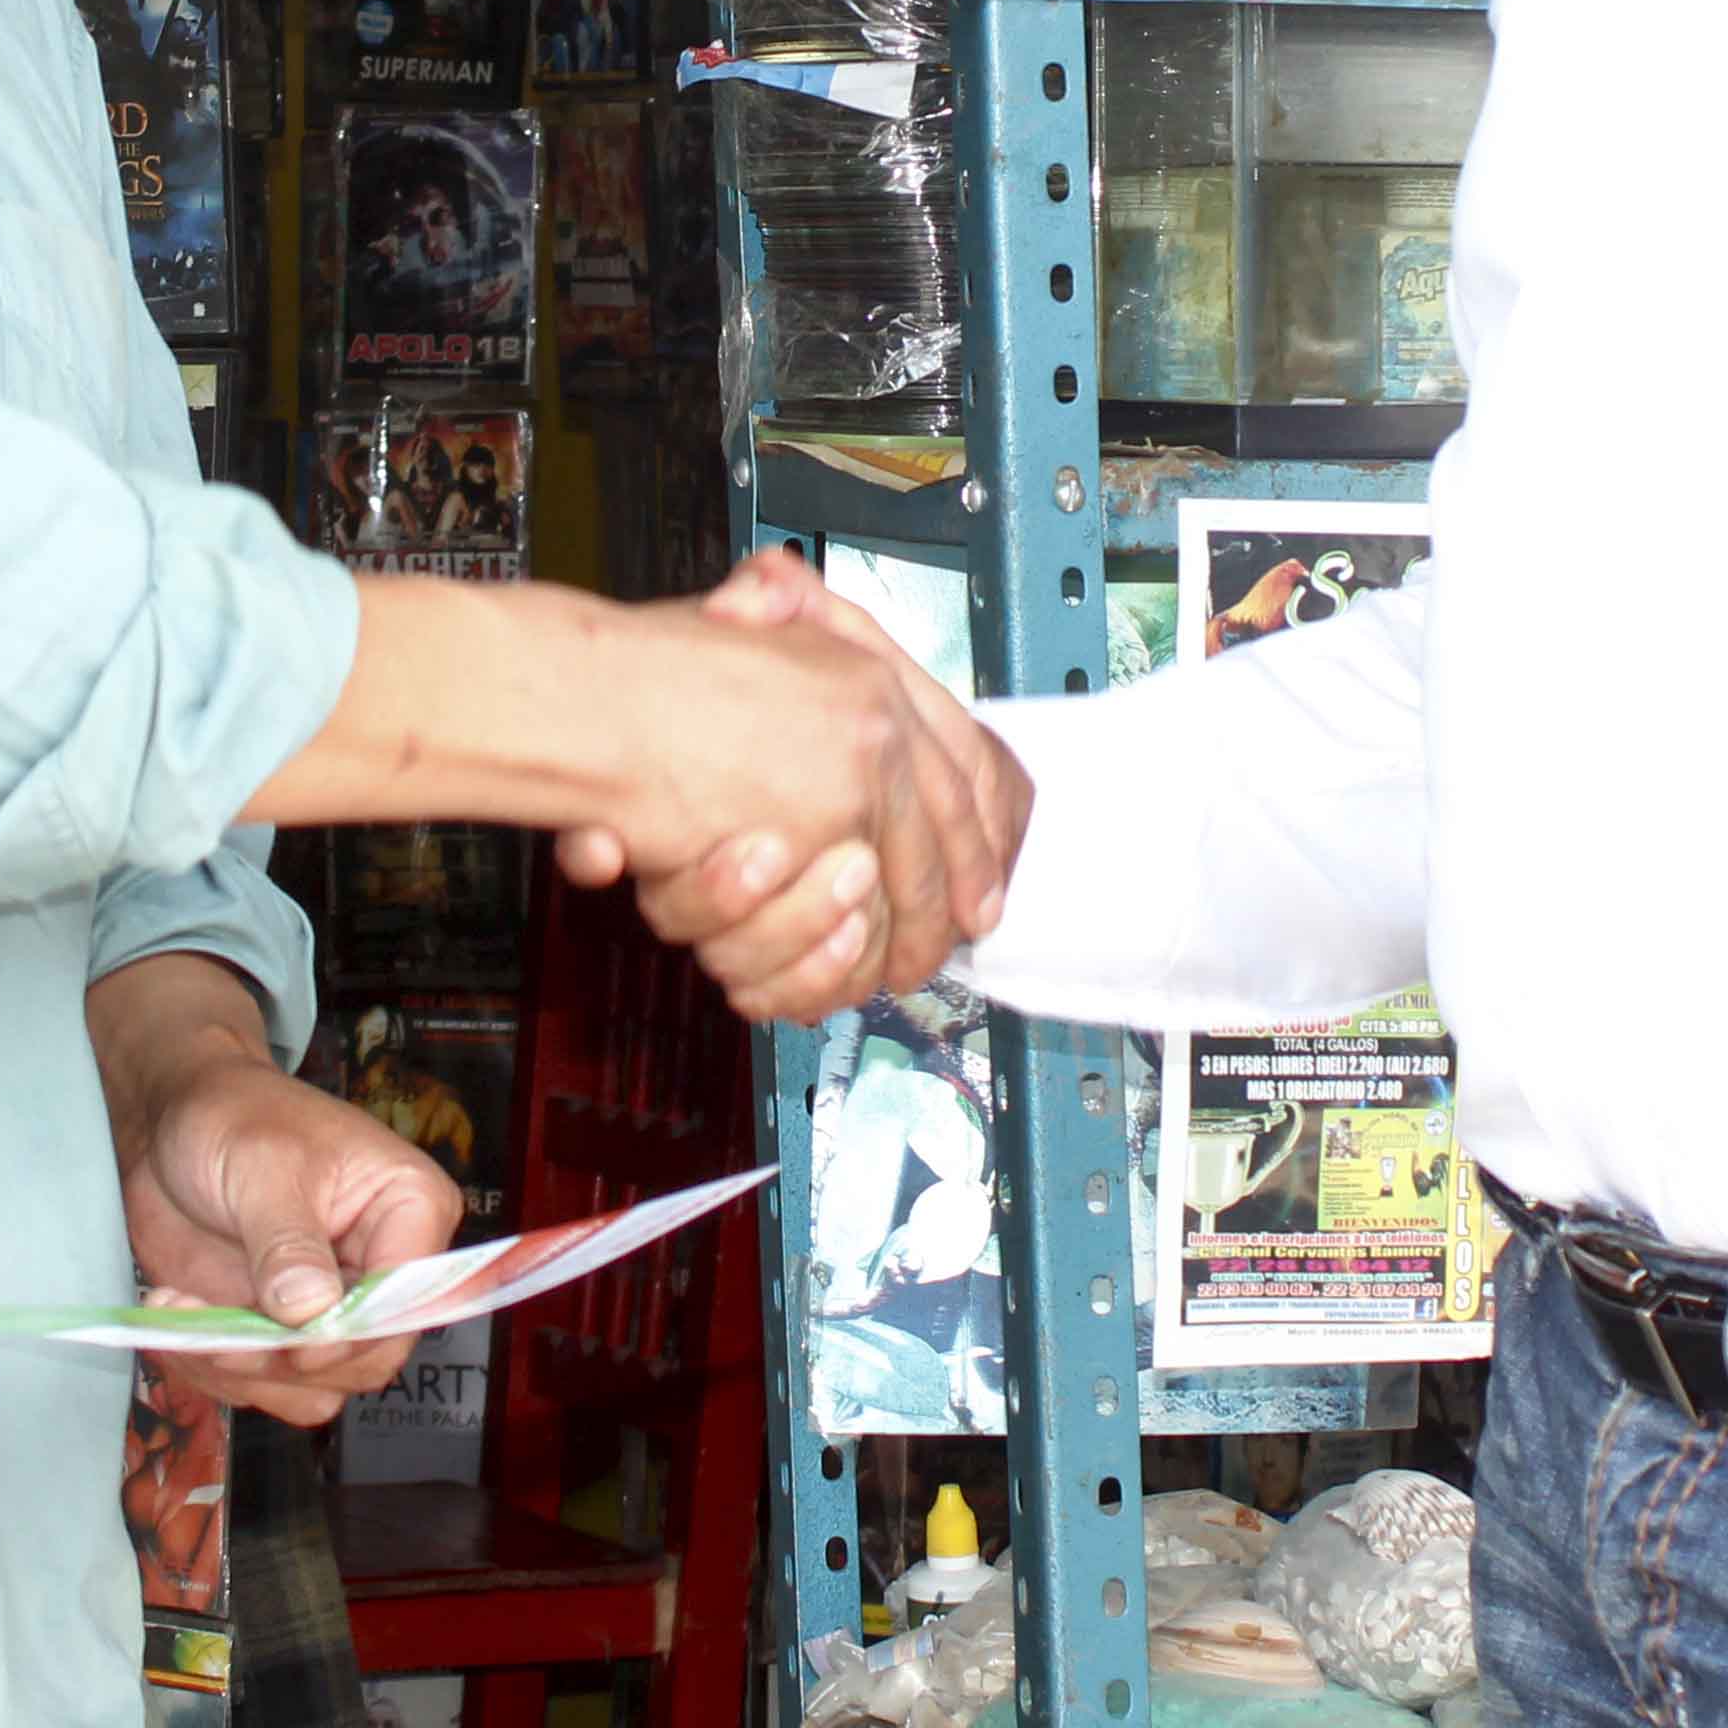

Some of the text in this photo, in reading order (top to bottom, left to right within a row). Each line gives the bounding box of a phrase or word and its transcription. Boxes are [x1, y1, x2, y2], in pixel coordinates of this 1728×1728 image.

[360, 55, 493, 87] SUPERMAN
[348, 333, 521, 363] APOLO 18
[1273, 1038, 1379, 1052] TOTAL GALLOS)
[1200, 1057, 1210, 1074] 3
[1212, 1056, 1228, 1074] EN
[1230, 1056, 1270, 1075] PESOS
[1272, 1056, 1315, 1075] LIBRES
[1247, 1080, 1365, 1100] MAS OBLIGATORIO
[1333, 1216, 1441, 1228] BIENVENIDOS
[387, 1408, 426, 1427] THE
